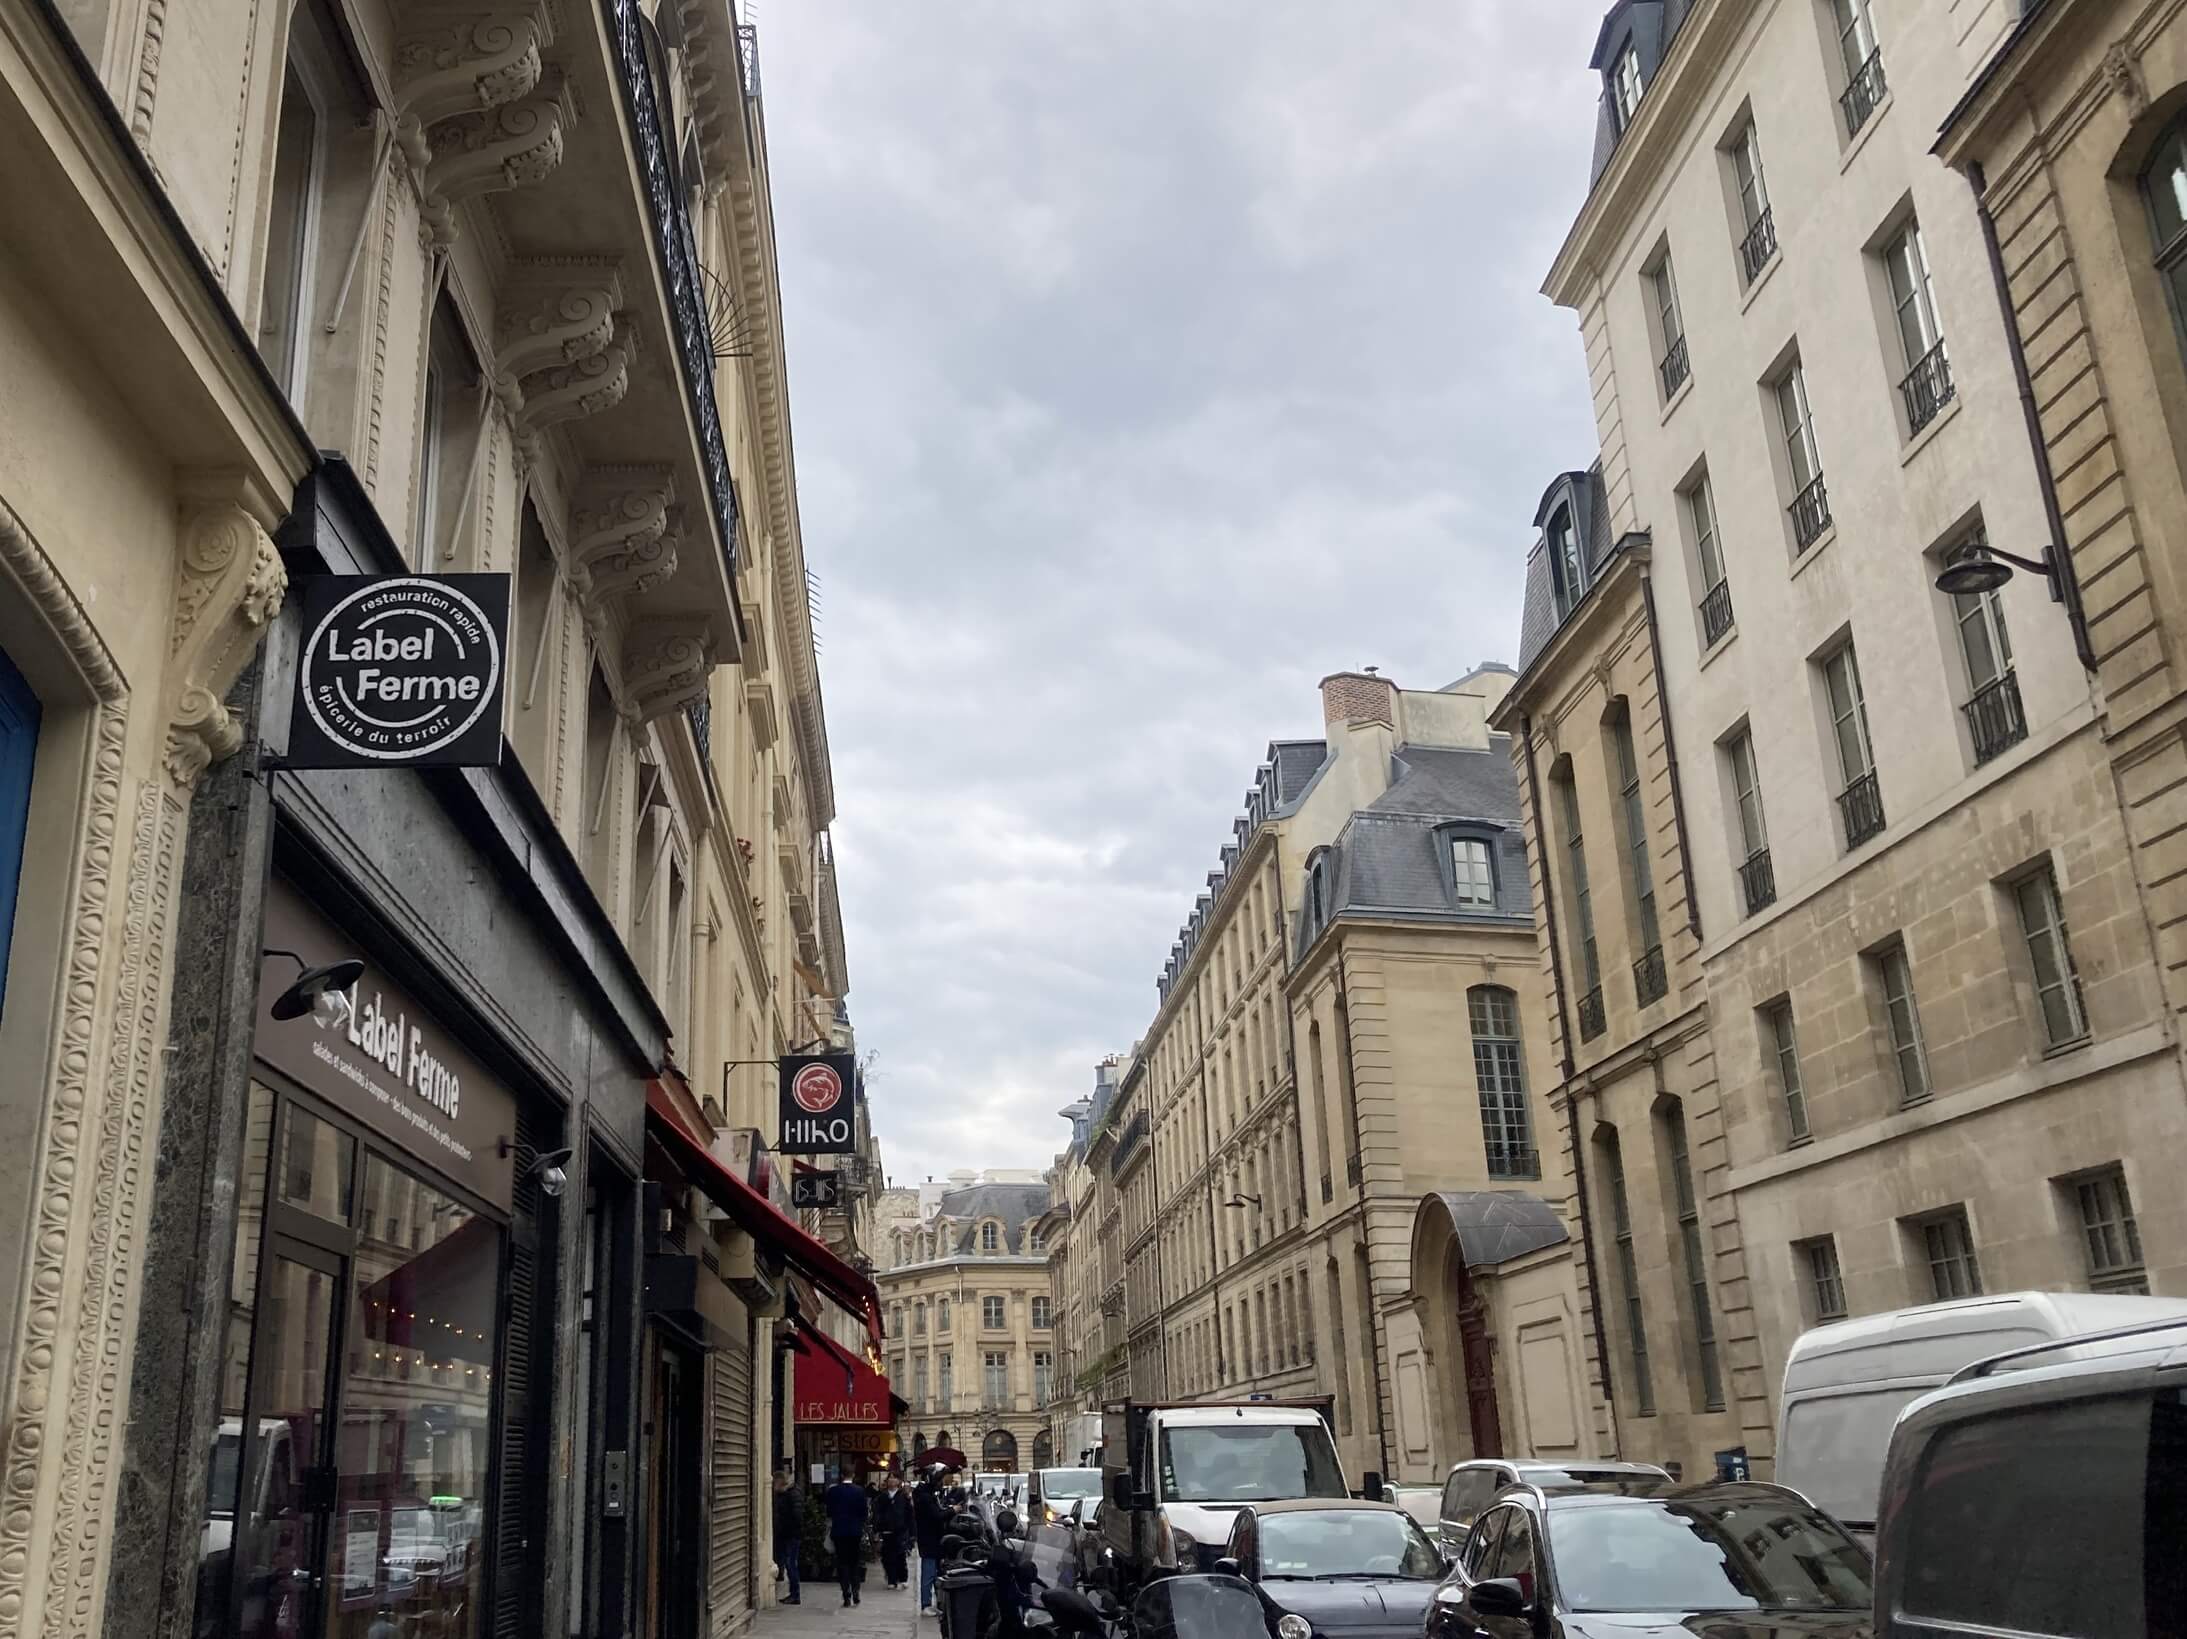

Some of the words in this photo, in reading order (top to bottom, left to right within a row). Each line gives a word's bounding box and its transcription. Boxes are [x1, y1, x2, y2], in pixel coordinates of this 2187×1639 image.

[360, 591, 450, 613] restauration
[449, 607, 481, 645] rapide
[328, 627, 435, 662] Label
[357, 668, 481, 701] Ferme
[319, 684, 364, 737] épicerie
[368, 731, 389, 744] du
[396, 716, 452, 744] terroir
[348, 980, 405, 1078] Label
[406, 1025, 460, 1120] Ferme
[784, 1118, 849, 1144] HIKO
[800, 1402, 824, 1421] LES
[831, 1402, 879, 1421] JALLES
